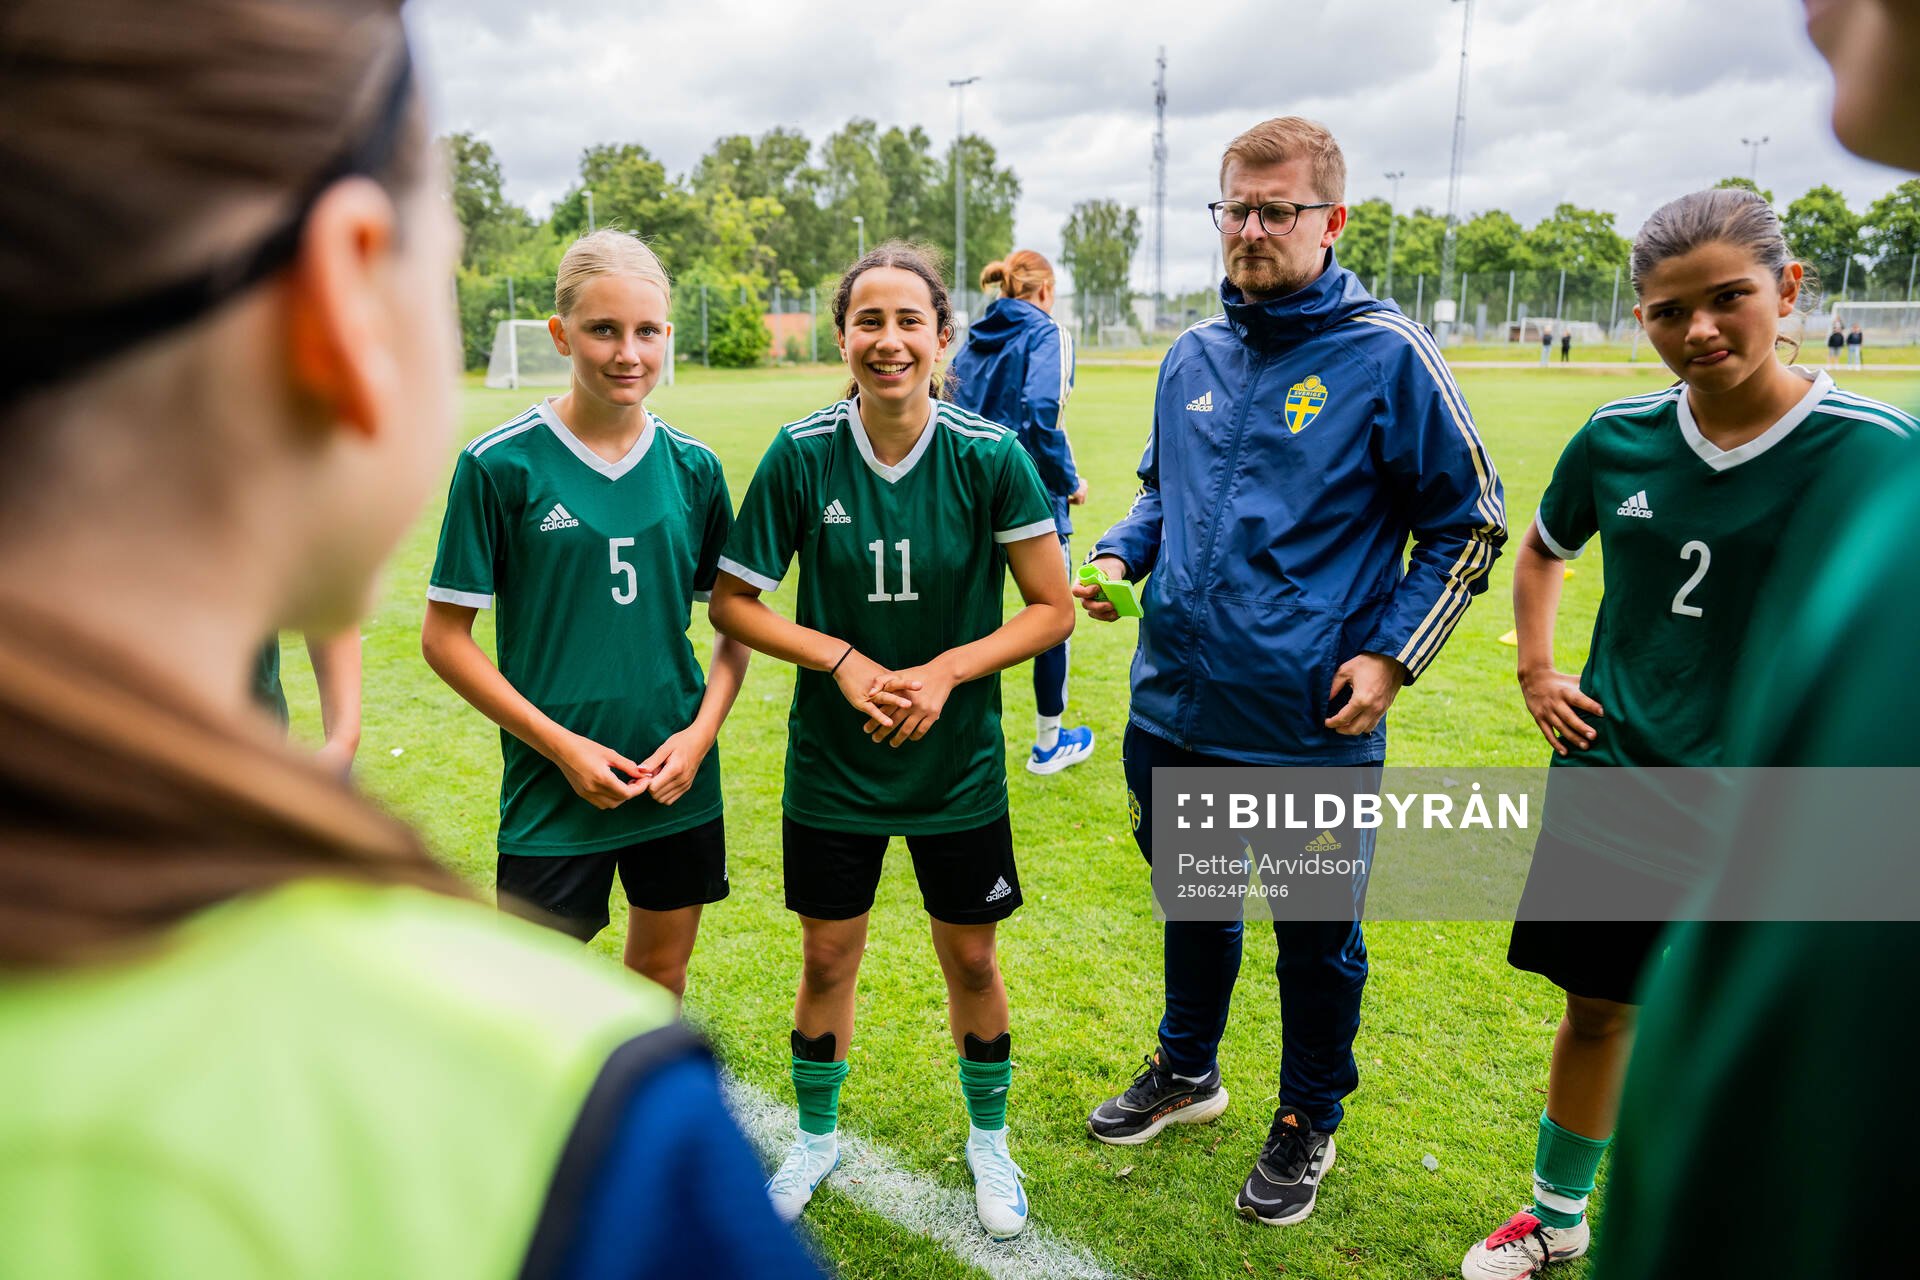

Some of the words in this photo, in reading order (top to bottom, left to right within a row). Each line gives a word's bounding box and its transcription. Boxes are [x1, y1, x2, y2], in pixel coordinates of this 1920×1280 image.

[1185, 402, 1214, 412] adidas
[1617, 506, 1653, 519] adidas
[540, 518, 579, 531] adidas
[823, 515, 852, 524] didas
[609, 537, 638, 605] 5
[868, 538, 919, 602] 11
[1671, 540, 1711, 618] 2
[1305, 842, 1342, 852] adidas
